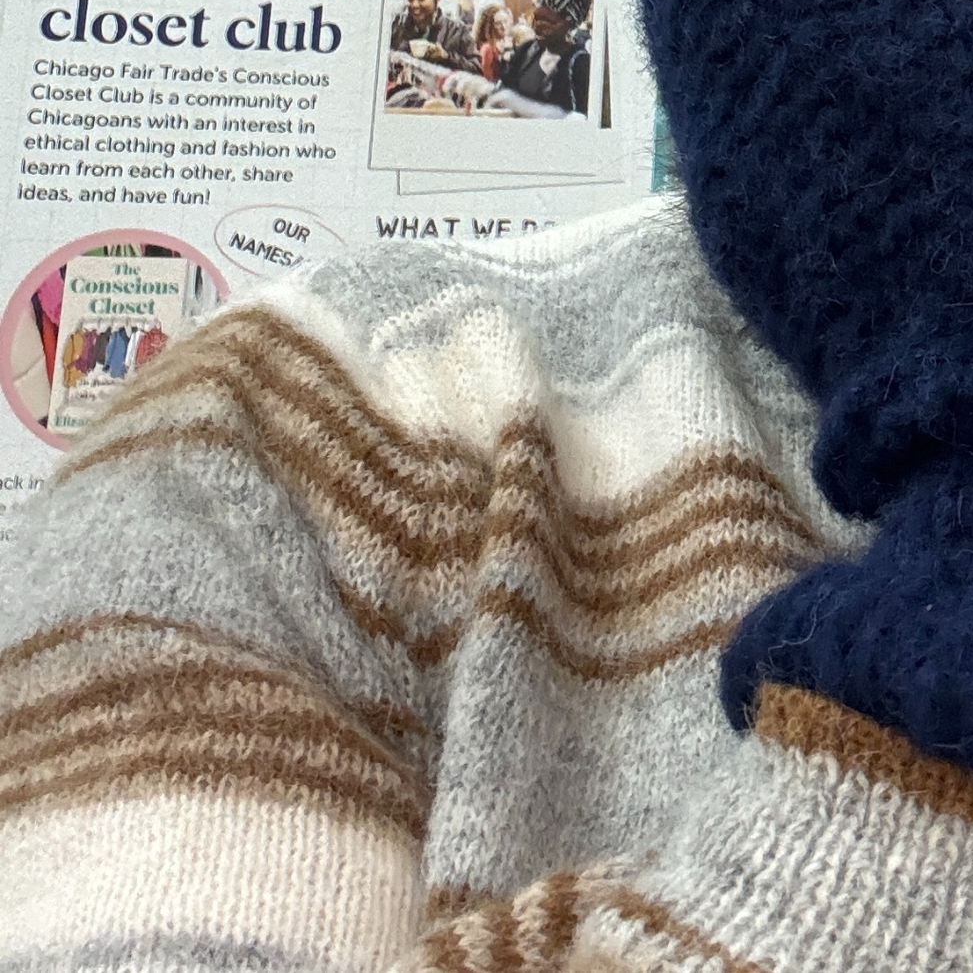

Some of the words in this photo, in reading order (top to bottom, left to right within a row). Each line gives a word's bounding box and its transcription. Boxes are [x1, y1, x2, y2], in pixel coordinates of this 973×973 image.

[224, 1, 342, 54] club
[33, 59, 115, 81] Chicago
[120, 62, 154, 78] Fair
[159, 64, 228, 83] Trade's
[232, 67, 330, 87] Conscious
[31, 83, 92, 102] Closet
[98, 86, 144, 103] Club
[149, 89, 164, 105] is
[168, 92, 180, 105] a
[185, 93, 293, 113] community
[297, 94, 318, 110] of
[27, 108, 142, 130] Chicagoans
[147, 113, 189, 130] with
[194, 117, 217, 131] an
[222, 115, 293, 133] interest
[298, 119, 316, 134] in
[24, 134, 90, 152] ethical
[95, 135, 175, 158] clothing
[180, 140, 216, 156] and
[221, 140, 290, 157] fashion
[295, 143, 337, 160] who
[20, 157, 71, 176] learn
[76, 159, 123, 177] from
[128, 163, 175, 179] each
[180, 164, 236, 183] other,
[242, 165, 294, 183] share
[17, 183, 73, 203] ideas,
[78, 186, 117, 203] and
[122, 186, 167, 204] have
[172, 188, 211, 205] fun!
[273, 217, 310, 243] OUR
[376, 215, 460, 239] WHAT
[471, 217, 511, 239] WE
[114, 262, 141, 276] The
[70, 276, 179, 295] Conscious
[89, 297, 155, 315] Closet
